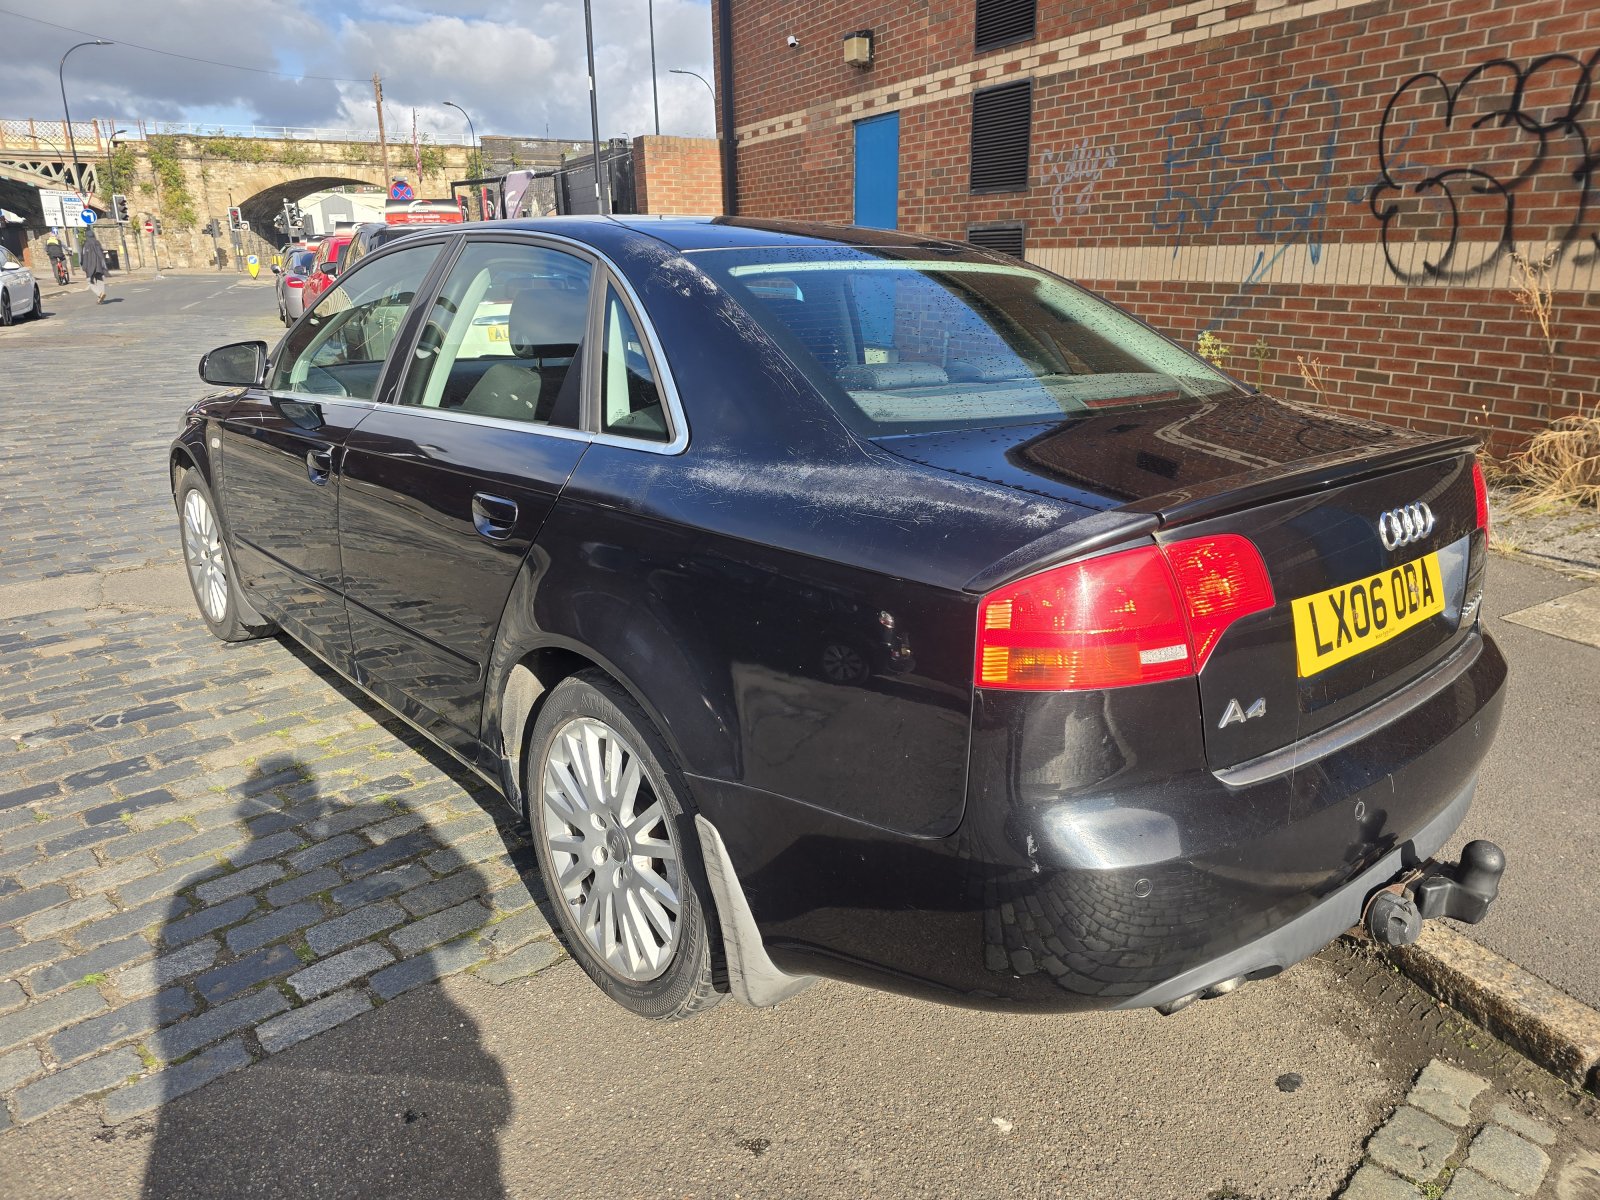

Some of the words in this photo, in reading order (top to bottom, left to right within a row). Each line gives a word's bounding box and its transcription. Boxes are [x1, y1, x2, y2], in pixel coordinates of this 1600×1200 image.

[1308, 577, 1388, 657] LX06
[1391, 558, 1435, 620] OBA
[1218, 697, 1267, 729] A4
